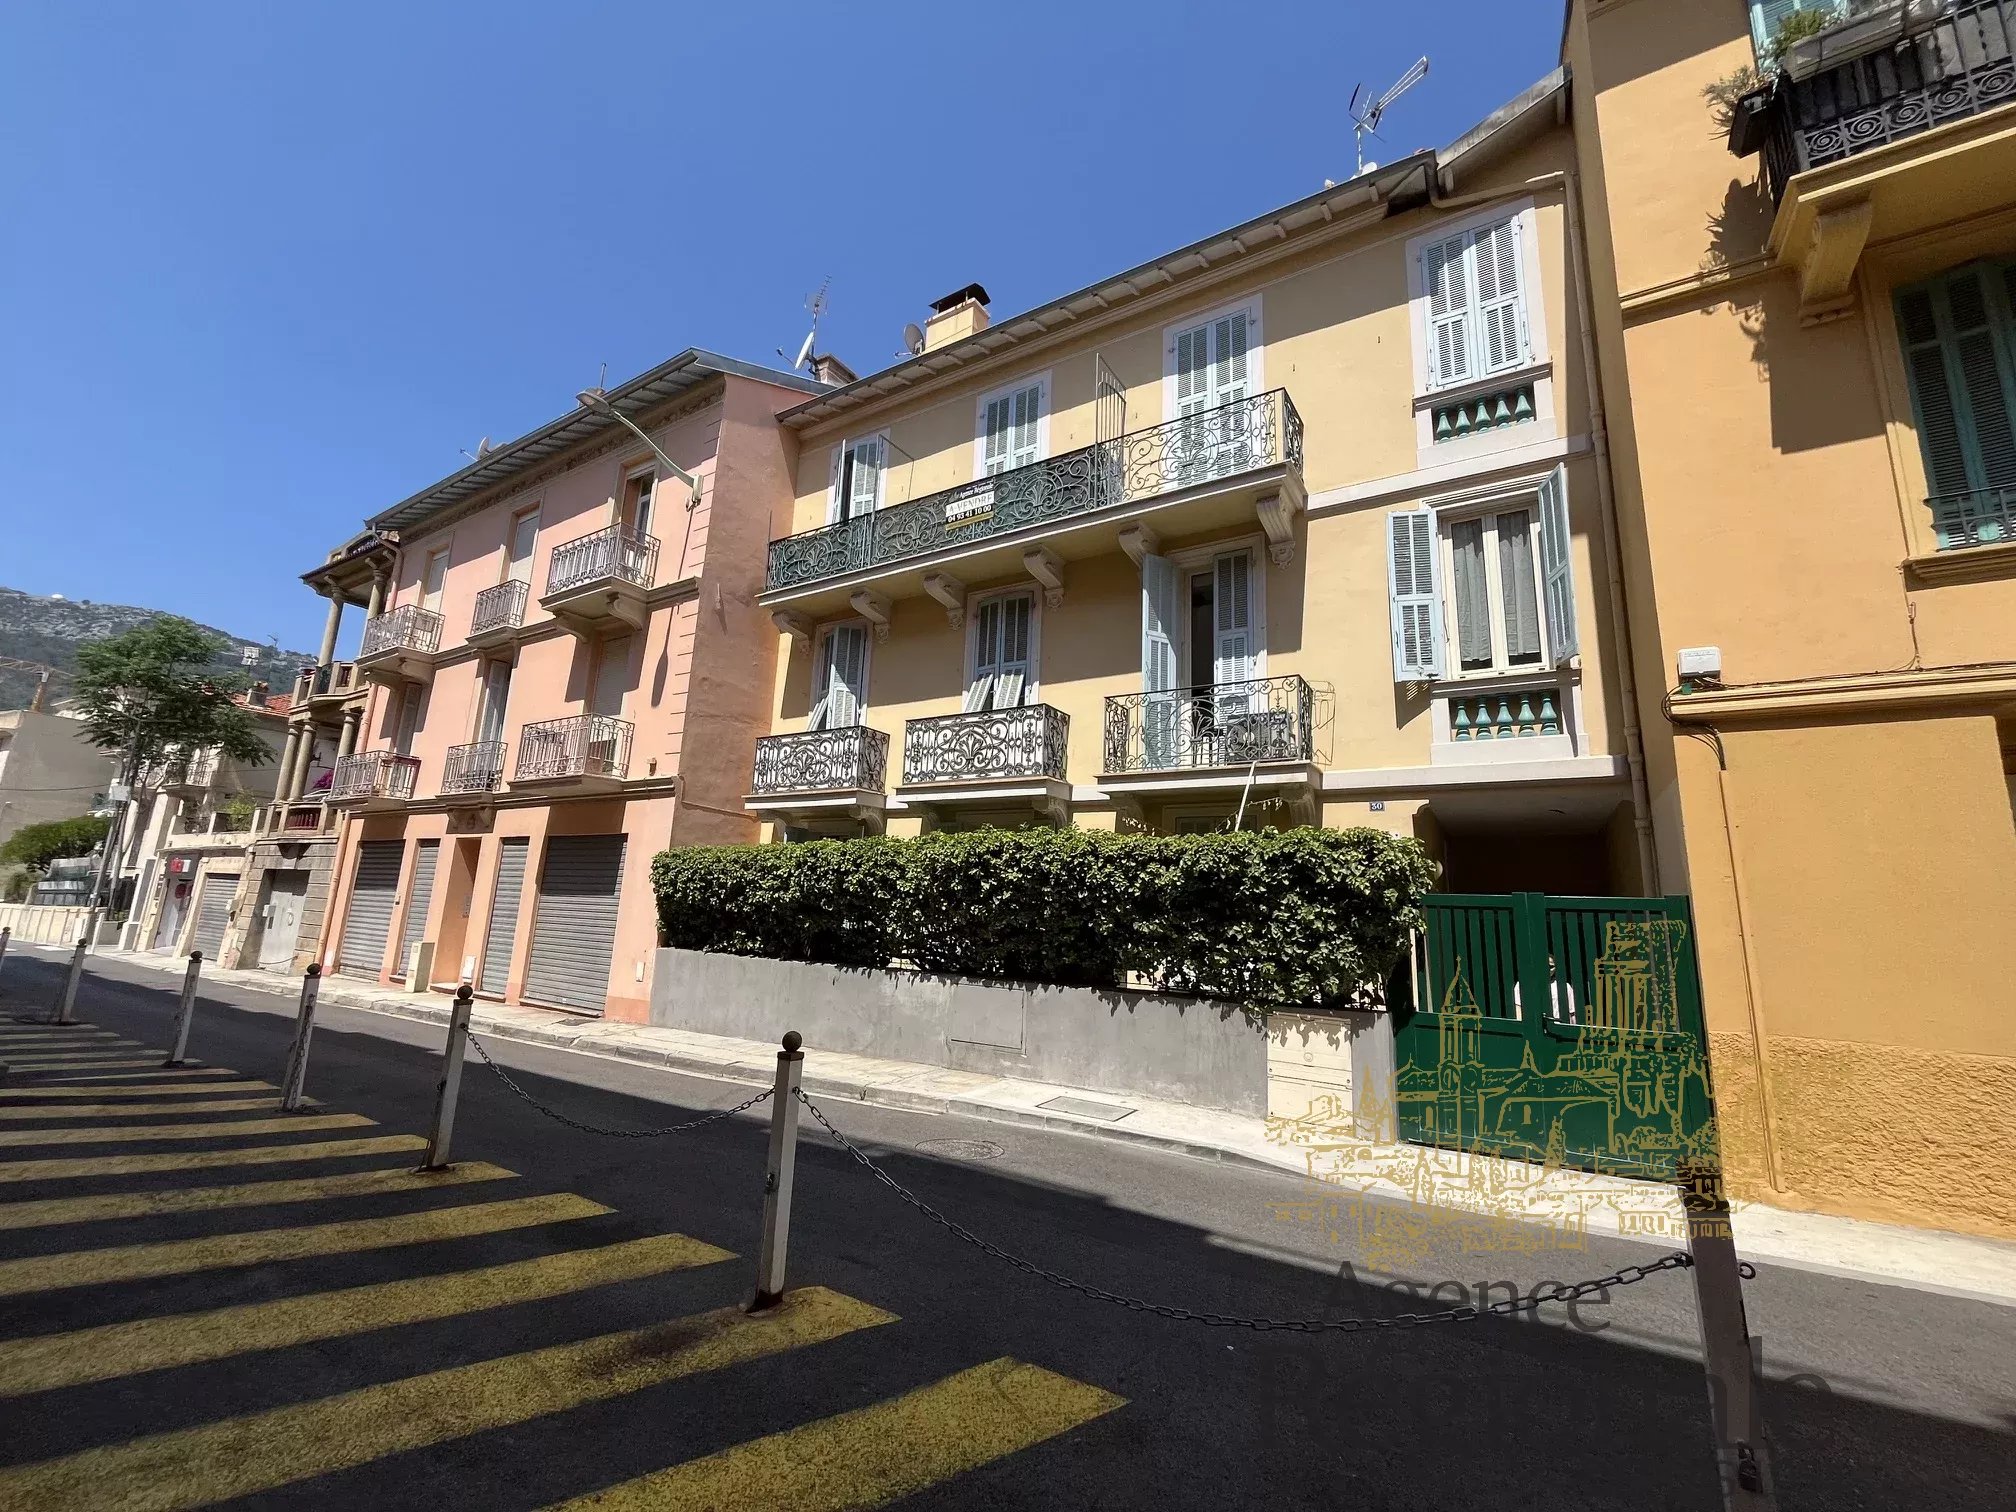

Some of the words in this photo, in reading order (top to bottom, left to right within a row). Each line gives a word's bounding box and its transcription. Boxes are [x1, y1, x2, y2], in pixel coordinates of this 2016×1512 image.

[956, 494, 993, 511] VENDRE
[956, 512, 965, 520] 93
[1371, 802, 1382, 810] 30
